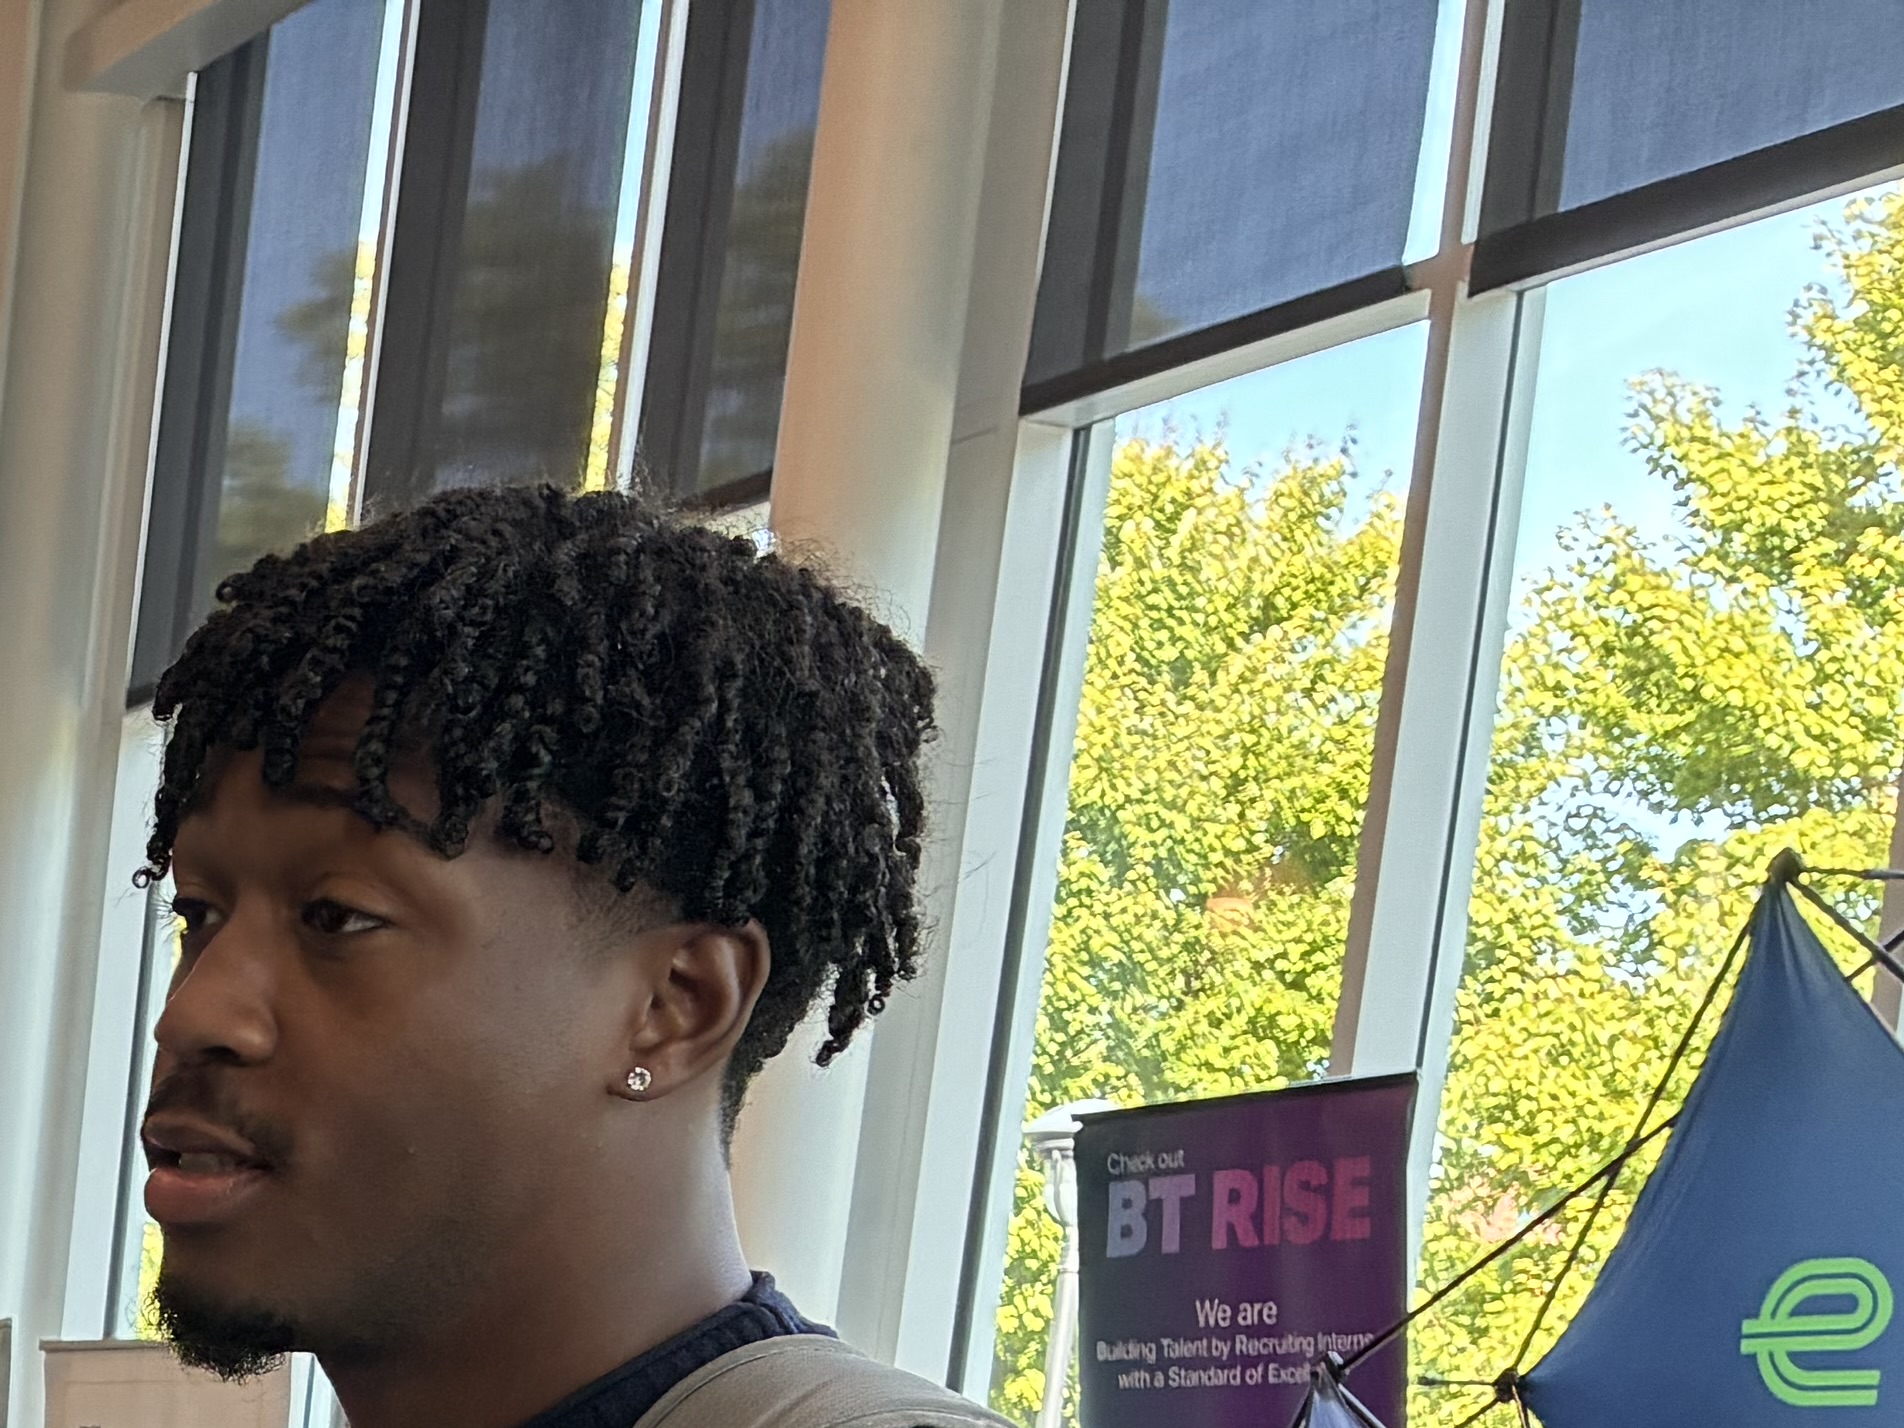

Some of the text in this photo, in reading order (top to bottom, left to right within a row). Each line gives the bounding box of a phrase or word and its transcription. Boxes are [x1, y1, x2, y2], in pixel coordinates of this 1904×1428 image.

[1106, 1147, 1185, 1175] Check out
[1105, 1156, 1372, 1259] BT RISE
[1196, 1299, 1278, 1327] We are
[1096, 1338, 1157, 1364] Building
[1161, 1336, 1209, 1359] Talent
[1212, 1336, 1231, 1361] by
[1235, 1332, 1315, 1357] Recruiting
[1118, 1366, 1151, 1390] with
[1153, 1370, 1165, 1389] a
[1168, 1363, 1241, 1389] Standard
[1245, 1362, 1264, 1385] of
